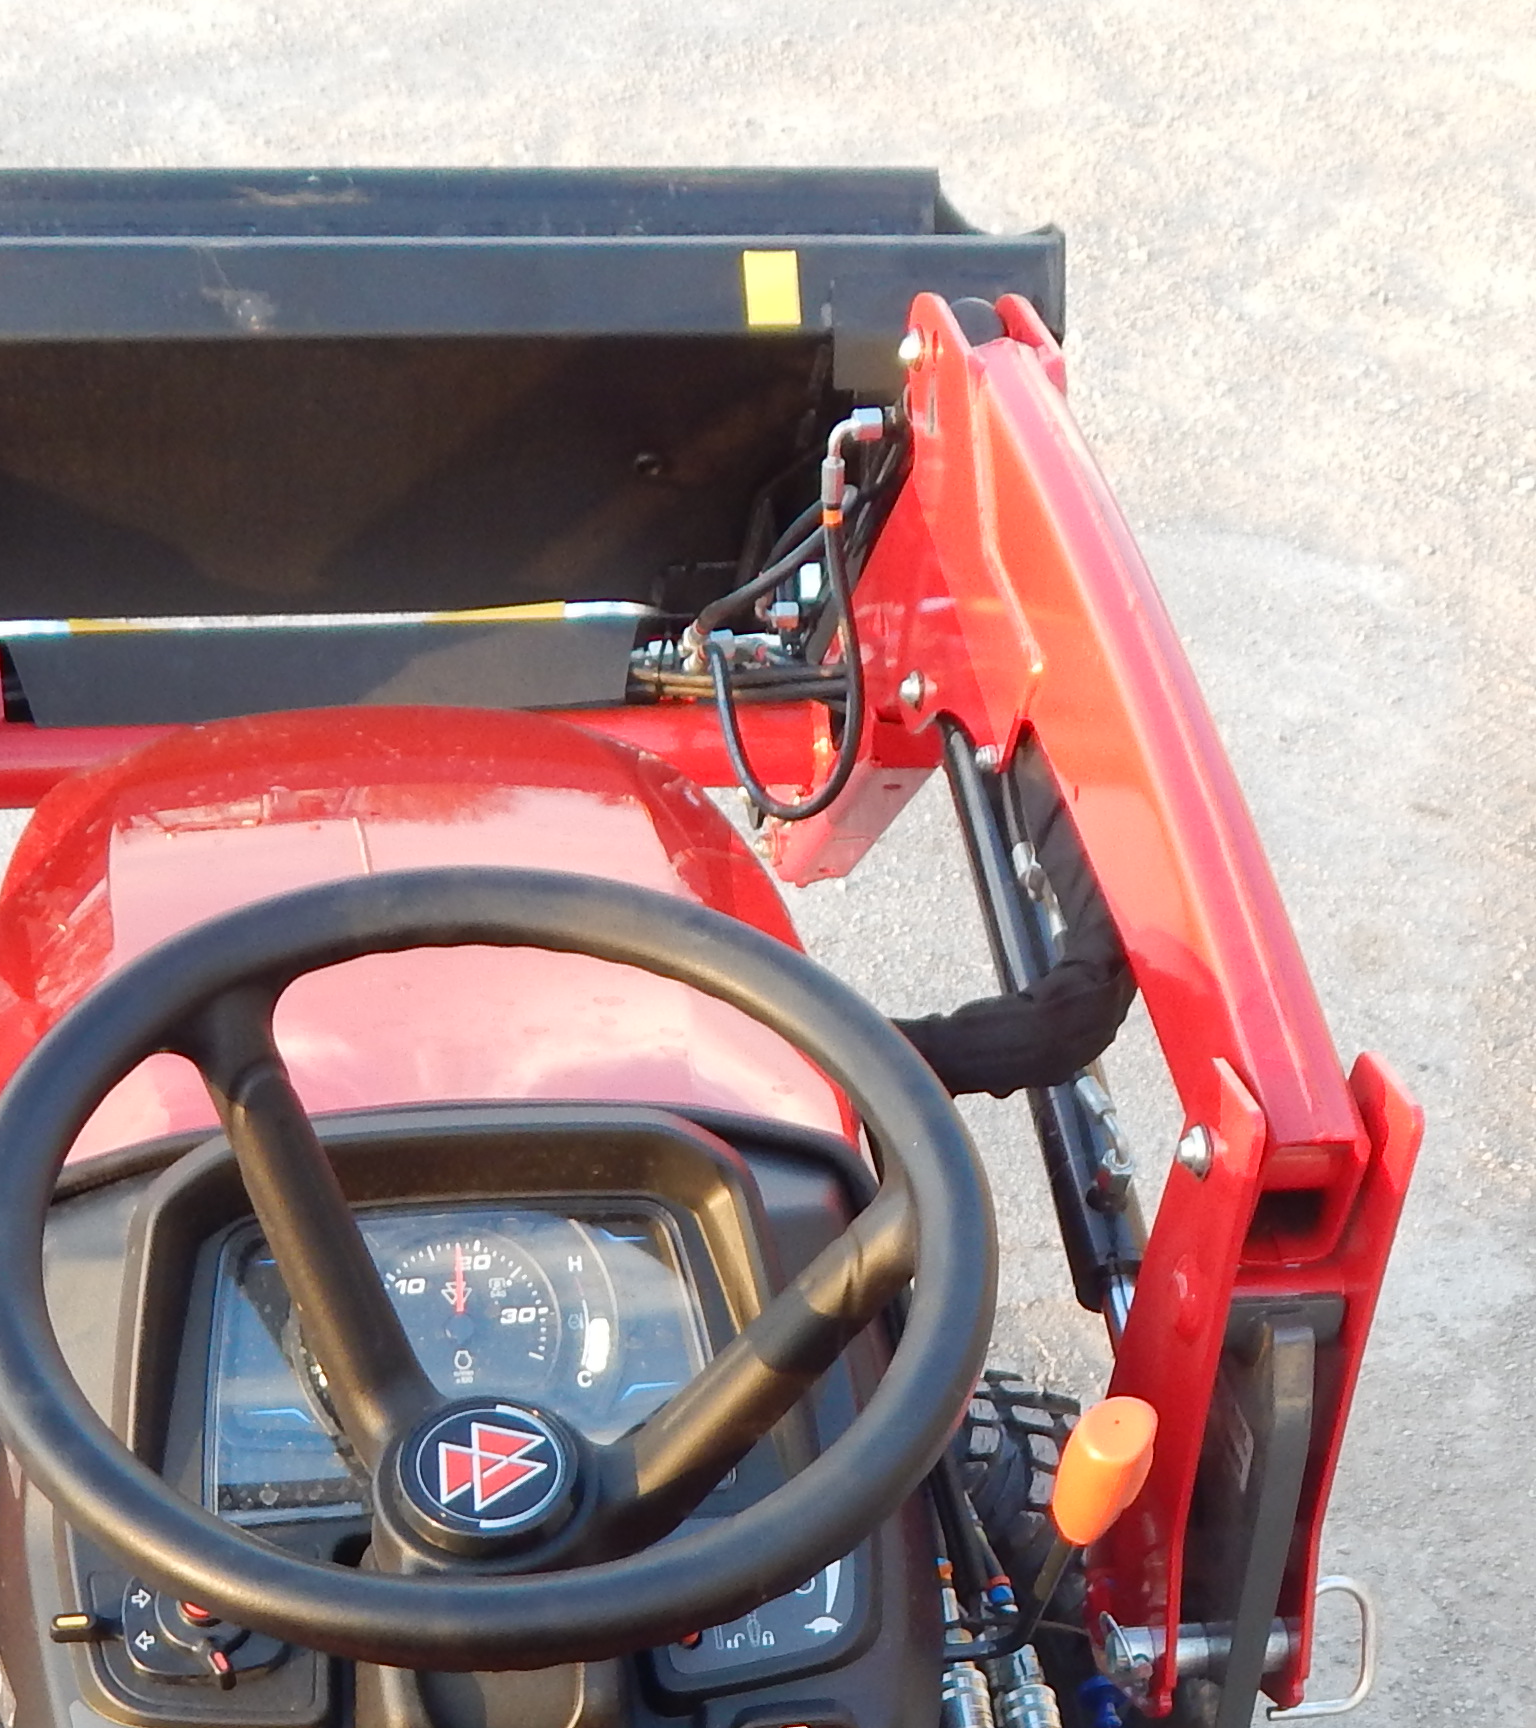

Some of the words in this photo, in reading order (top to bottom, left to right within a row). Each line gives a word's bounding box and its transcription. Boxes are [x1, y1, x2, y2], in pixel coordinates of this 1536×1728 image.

[457, 1254, 492, 1271] 20
[568, 1255, 583, 1272] H
[395, 1278, 426, 1295] 10
[500, 1306, 537, 1324] 30
[577, 1370, 593, 1388] C
